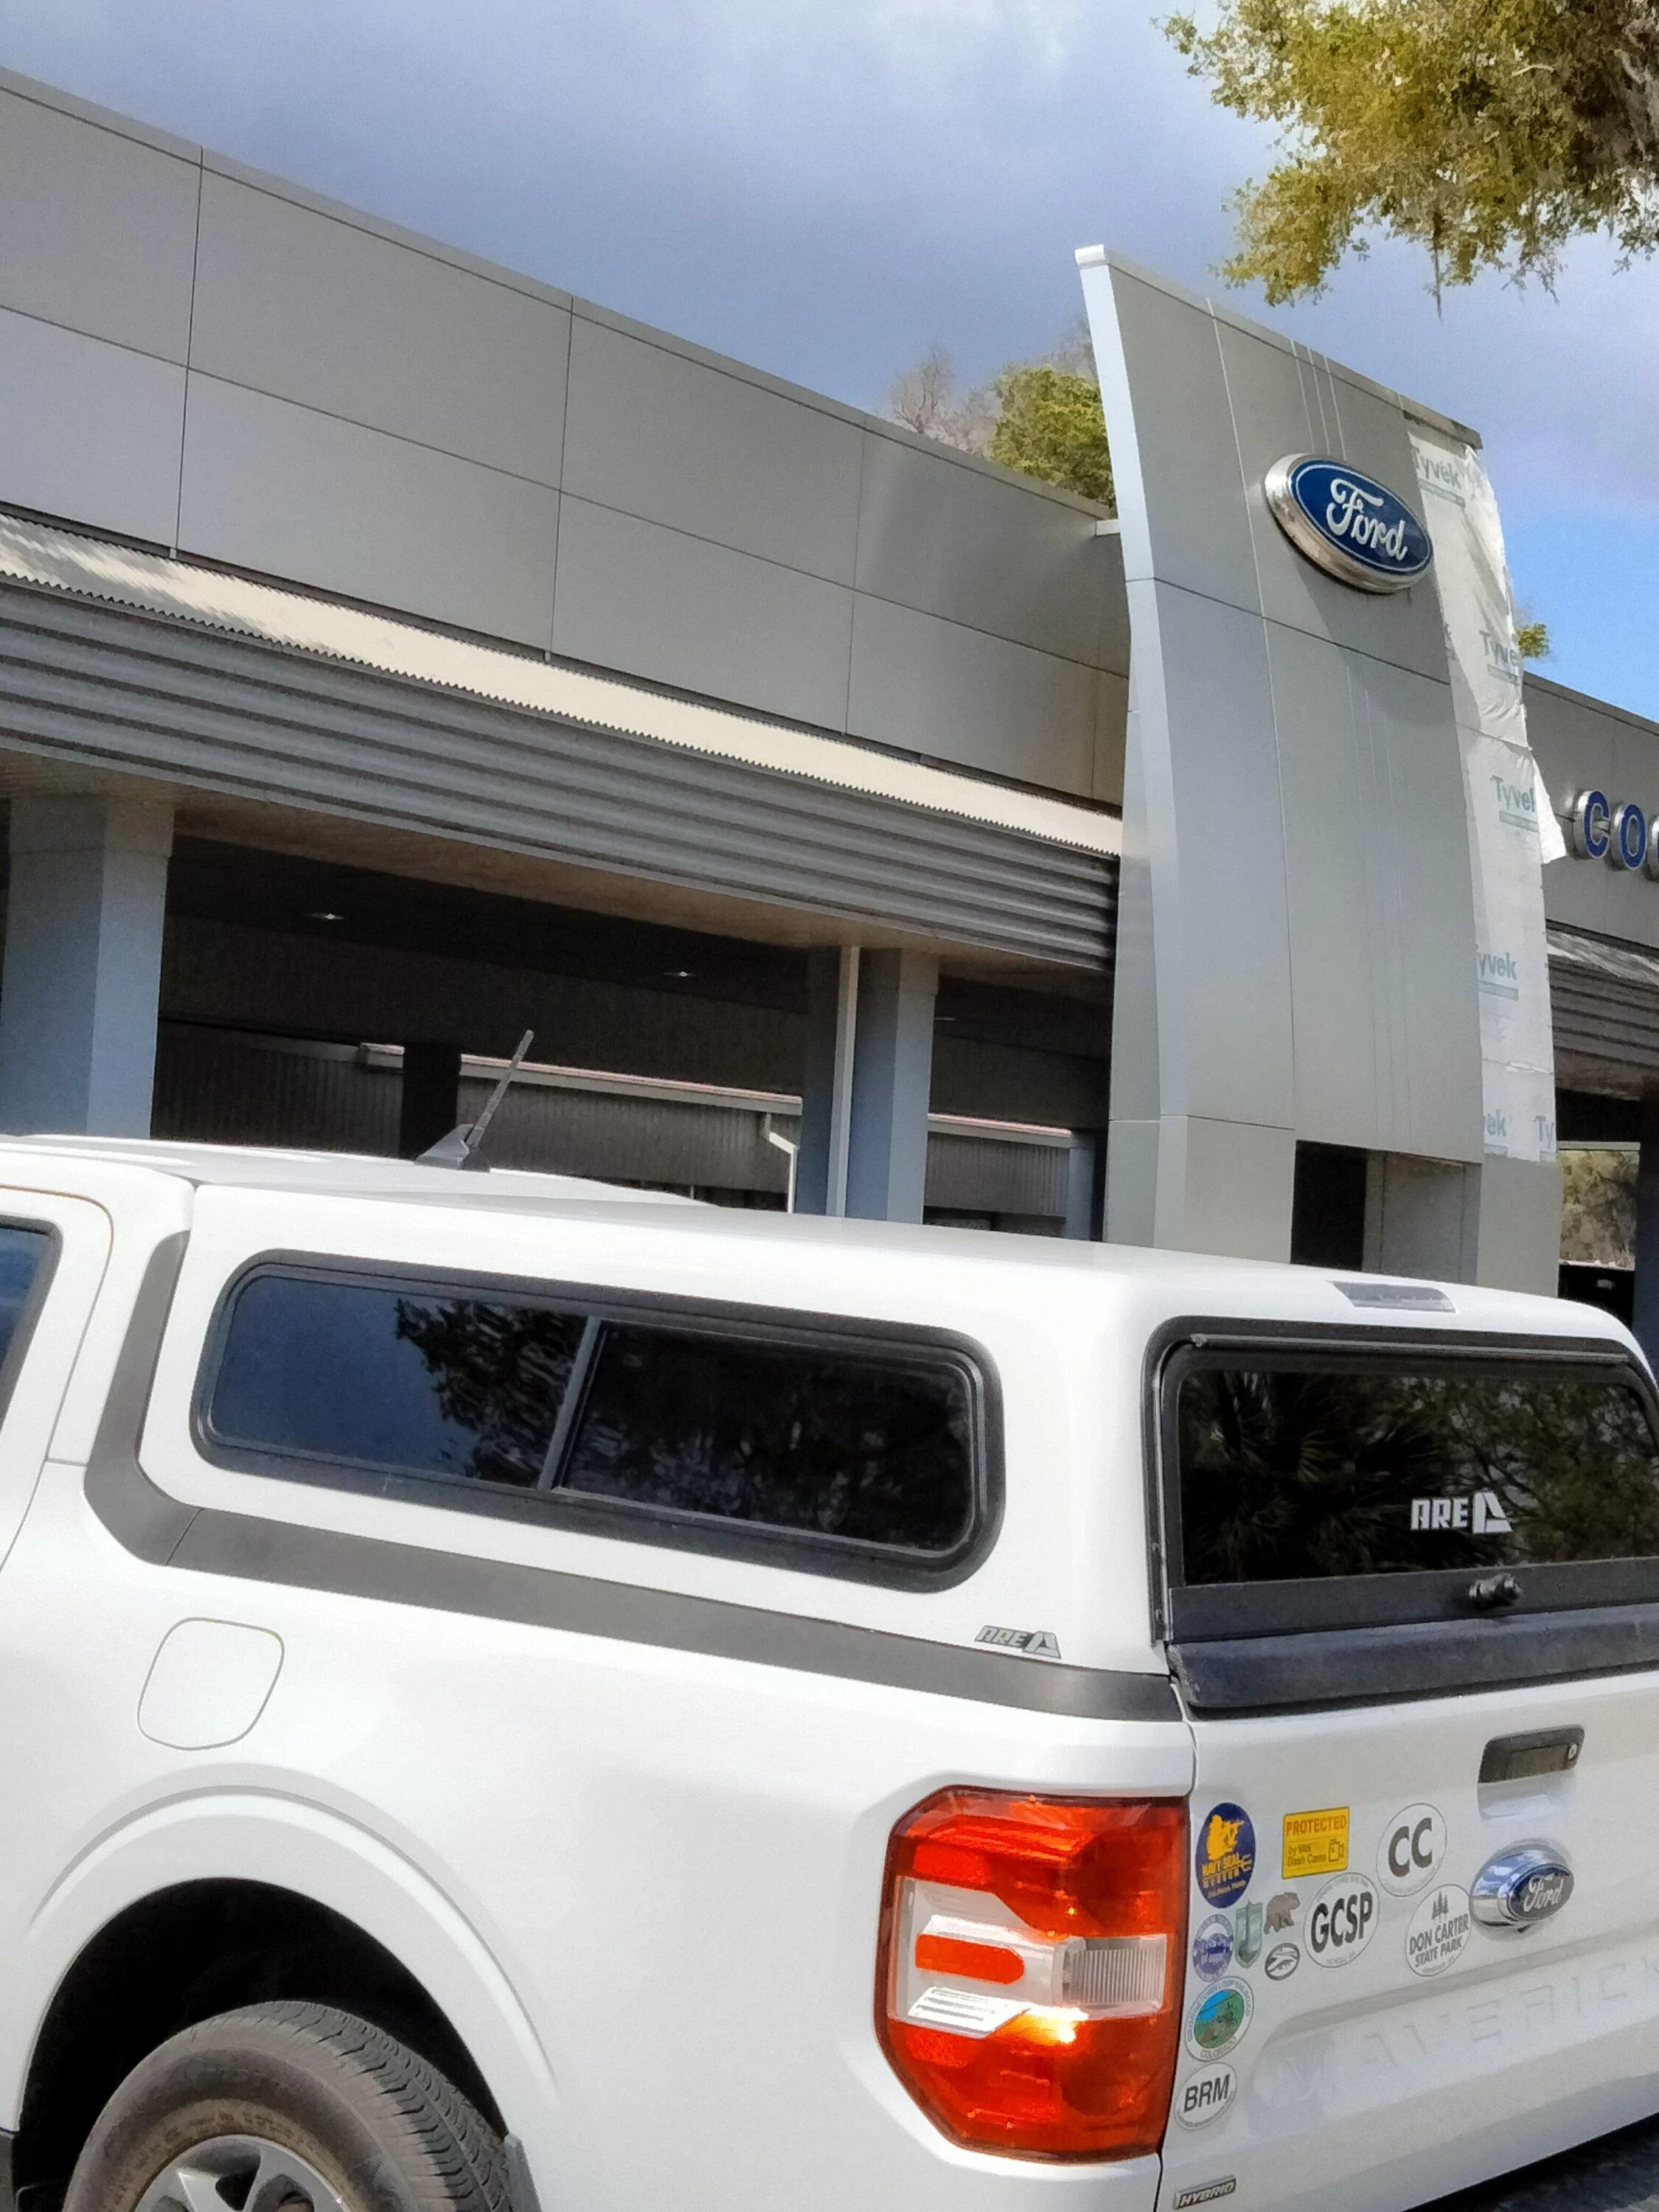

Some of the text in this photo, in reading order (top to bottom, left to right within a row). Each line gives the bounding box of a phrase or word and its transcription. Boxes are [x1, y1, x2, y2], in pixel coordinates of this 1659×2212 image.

[1326, 479, 1408, 561] Ford
[1479, 628, 1519, 667] Tyve
[1583, 789, 1659, 873] CO
[1477, 951, 1517, 981] yvek
[1286, 1815, 1347, 1837] PROTECTED
[1388, 1817, 1433, 1877] CC
[1523, 1874, 1564, 1912] Ford
[1311, 1892, 1373, 1953] GCSP
[1409, 1913, 1470, 1955] DON CARTER
[1415, 1946, 1438, 1968] STATE
[1440, 1935, 1463, 1957] PARK
[1183, 2073, 1231, 2113] BRM
[1179, 2181, 1235, 2207] HYBRID
